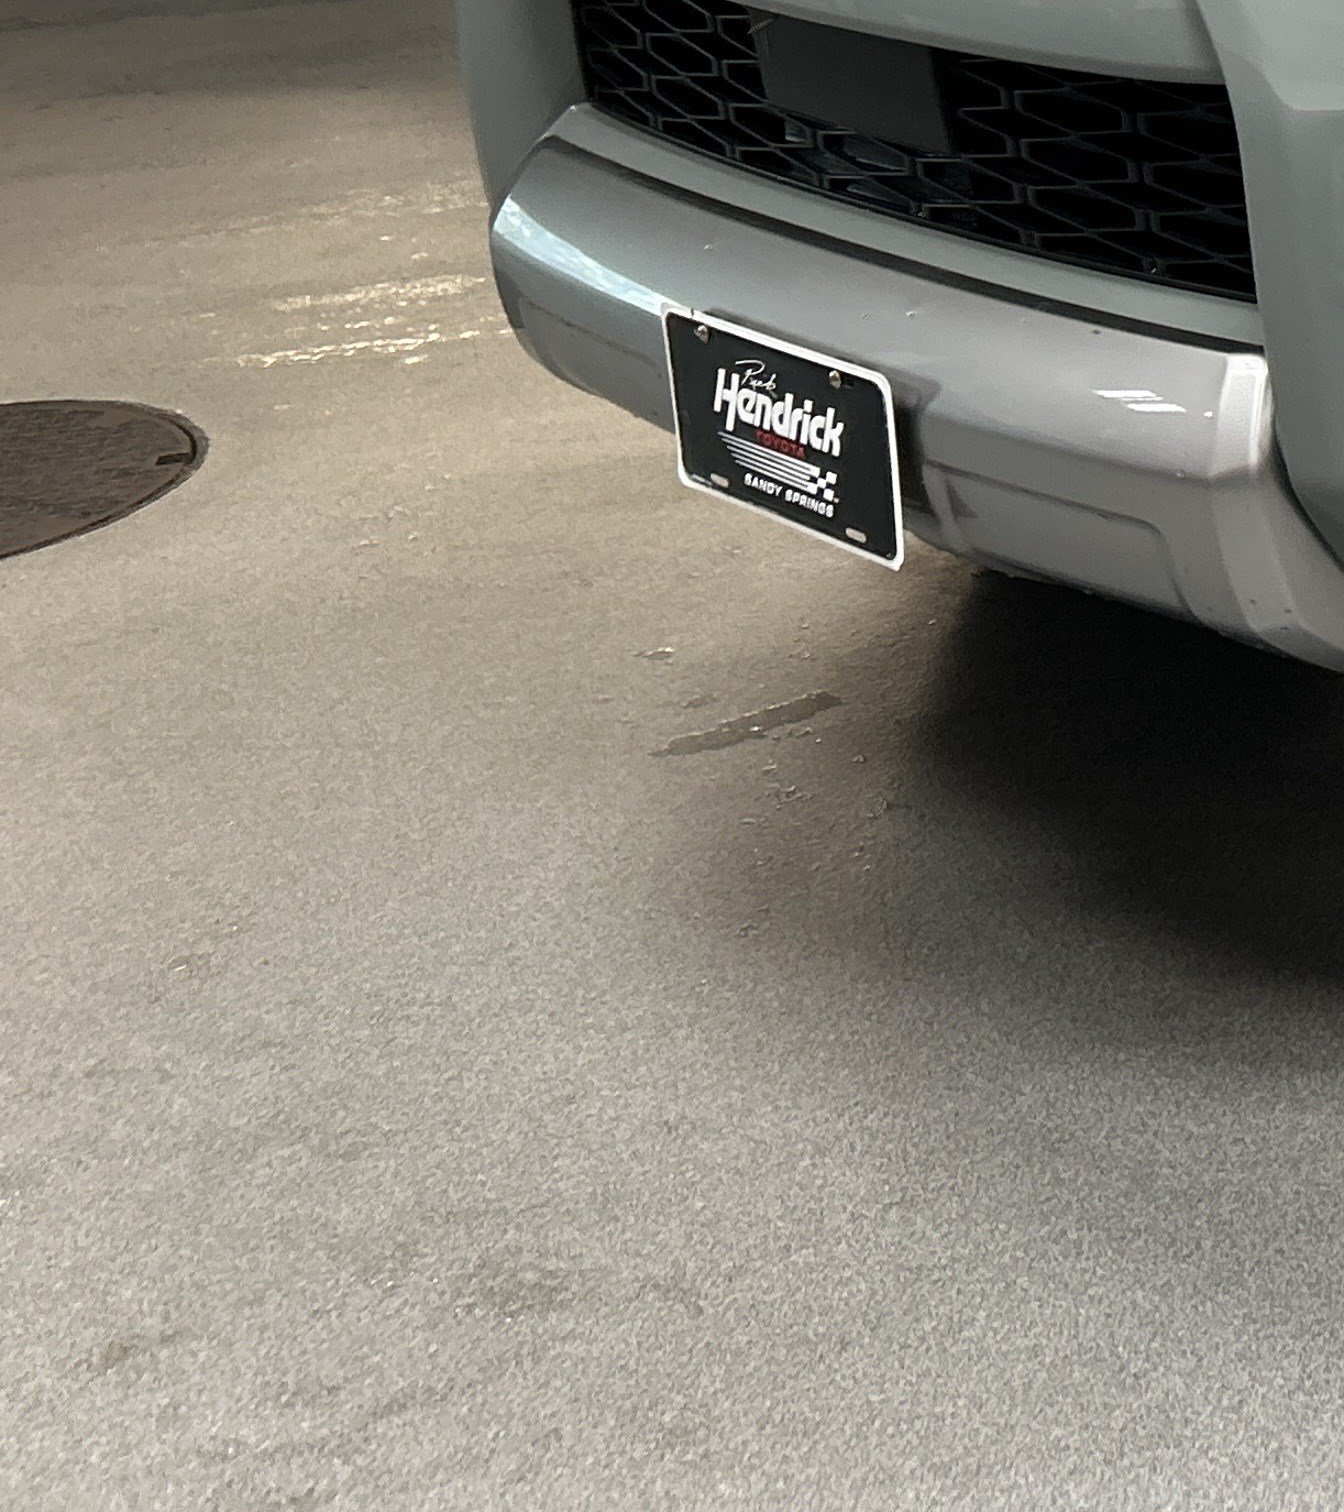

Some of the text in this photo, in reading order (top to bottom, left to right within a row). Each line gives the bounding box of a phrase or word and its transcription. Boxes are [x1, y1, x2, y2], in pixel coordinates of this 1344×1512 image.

[713, 367, 845, 457] Hendrick
[743, 472, 834, 518] SANDY SPRINGS
